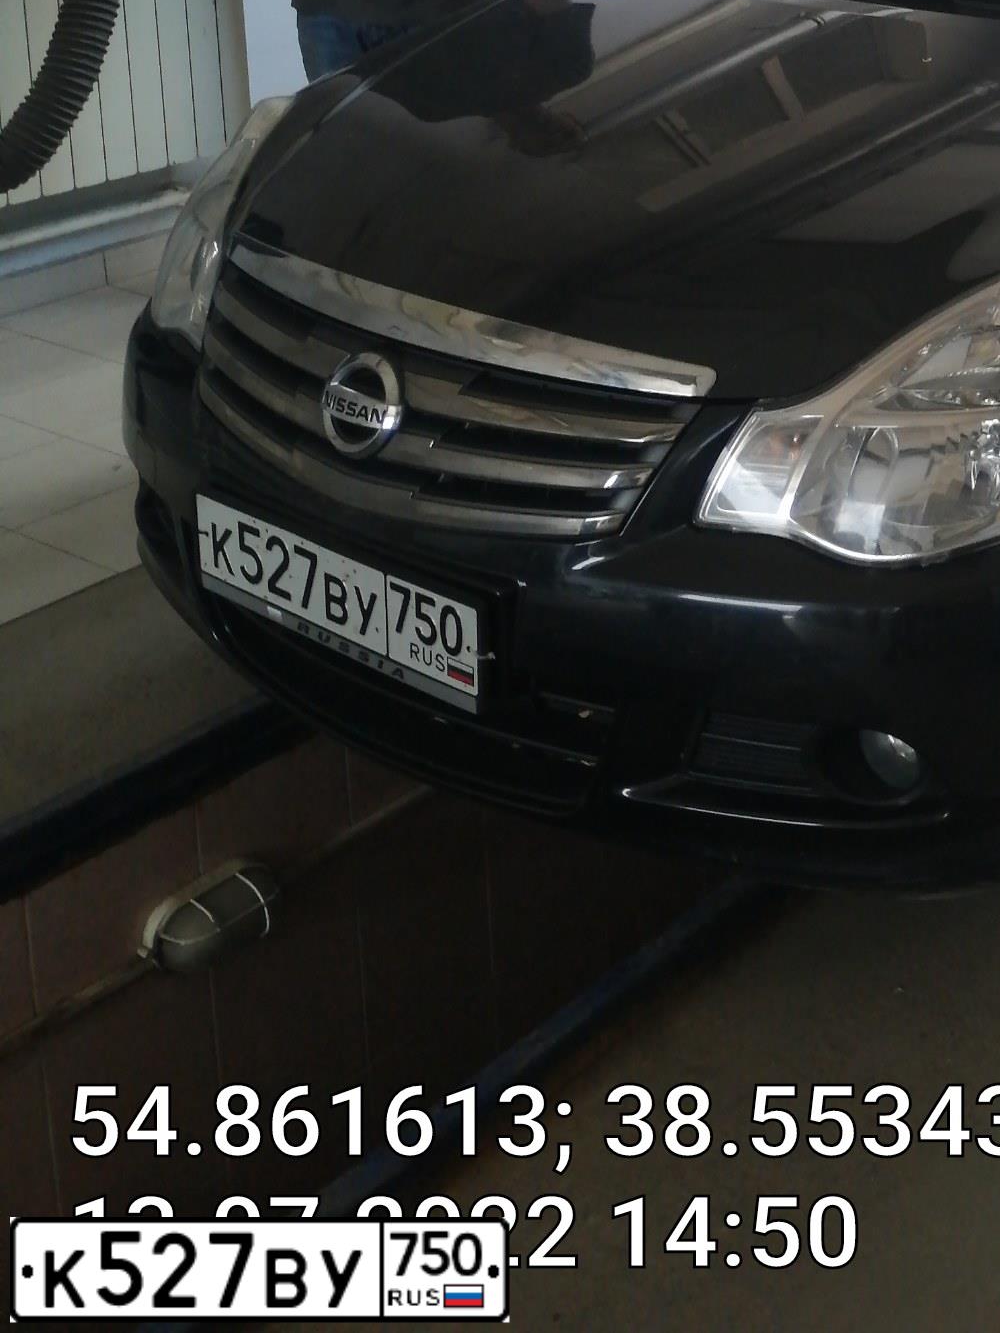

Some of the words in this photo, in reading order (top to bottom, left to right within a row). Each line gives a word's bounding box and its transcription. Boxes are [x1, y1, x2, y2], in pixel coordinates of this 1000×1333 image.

[324, 389, 388, 425] NISSAN
[389, 582, 464, 657] 750
[408, 642, 446, 673] RUS
